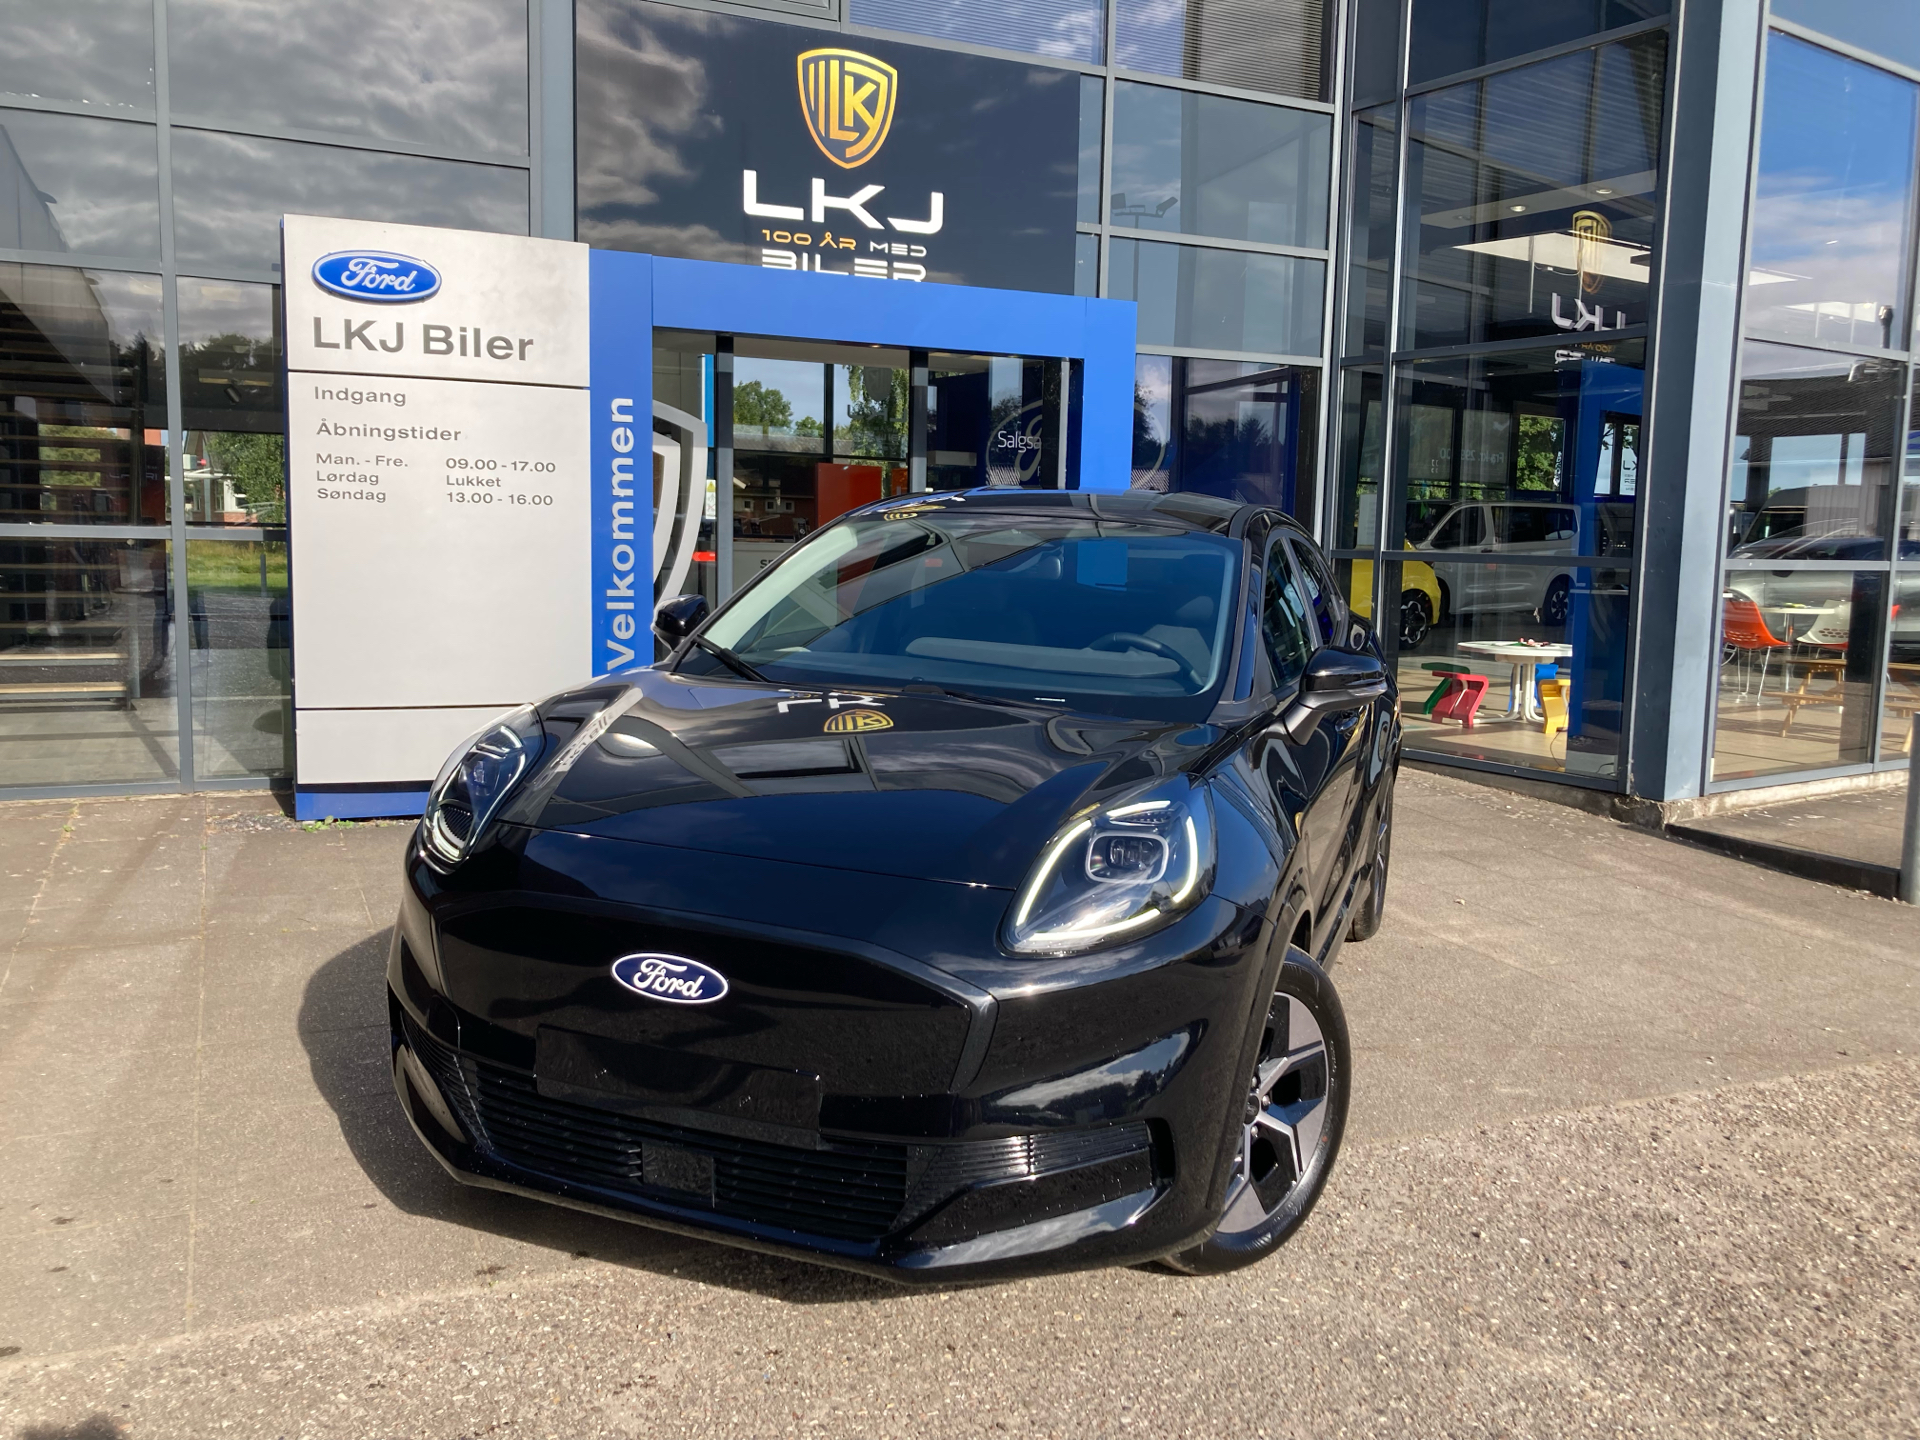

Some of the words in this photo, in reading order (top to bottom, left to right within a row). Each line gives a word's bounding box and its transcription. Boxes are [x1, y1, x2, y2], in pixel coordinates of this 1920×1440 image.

[743, 169, 944, 235] LKJ
[762, 229, 812, 246] 100
[818, 231, 857, 251] ÅR
[869, 240, 928, 258] MED
[341, 258, 418, 292] Ford
[762, 248, 927, 283] BILER
[313, 316, 404, 353] LKJ
[423, 324, 534, 361] Biler
[314, 386, 406, 407] Indgang
[316, 417, 462, 442] Åbningstider
[316, 452, 360, 466] Man.
[375, 455, 408, 467] Fre.
[445, 457, 498, 471] 09.00
[511, 460, 557, 473] 17.00
[316, 470, 379, 486] Lørdag
[446, 474, 502, 488] Lukket
[317, 487, 386, 504] Søndag
[446, 491, 494, 504] 13.00
[508, 493, 554, 506] 16.00
[606, 397, 636, 671] Velkommen
[633, 958, 706, 998] Ford
